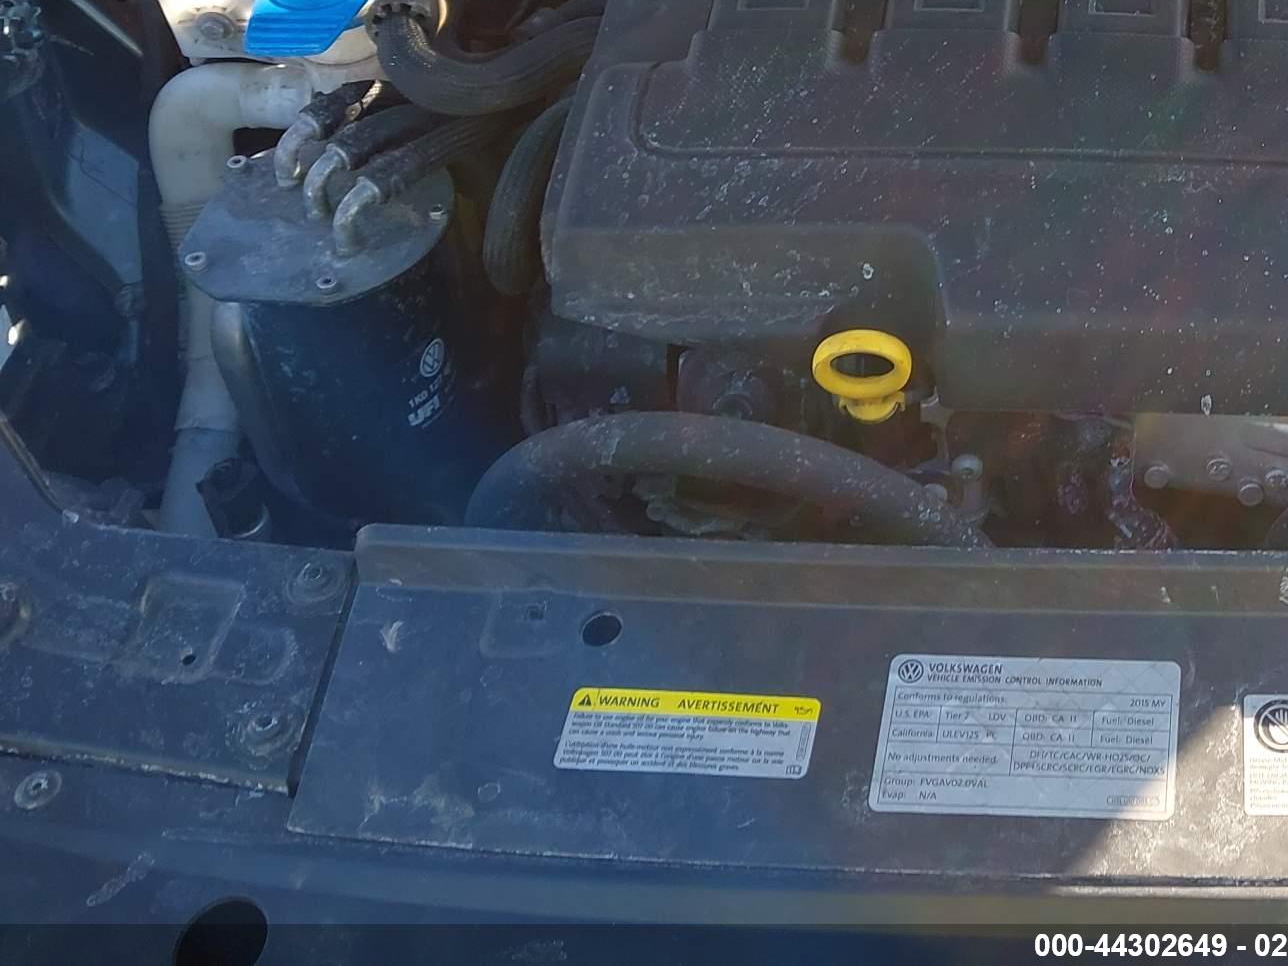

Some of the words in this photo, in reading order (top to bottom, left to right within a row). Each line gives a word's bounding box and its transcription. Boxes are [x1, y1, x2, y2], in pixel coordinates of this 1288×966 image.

[928, 663, 1003, 675] VOLKSWAGEN
[926, 673, 960, 683] VEHICLE
[962, 674, 1002, 684] EMISSION
[1004, 675, 1041, 686] CONTROL
[1045, 677, 1103, 687] INFORMATION
[897, 692, 941, 701] Conforms
[599, 695, 660, 708] WARNING
[677, 698, 780, 715] AVERTISSEMENT
[1129, 698, 1150, 707] 2015
[1151, 698, 1167, 708] MY
[945, 711, 962, 720] Tier
[987, 713, 1007, 722] LDV
[1051, 714, 1065, 723] CA
[1127, 717, 1155, 727] Diesel
[1049, 733, 1063, 742] CA
[1125, 735, 1153, 745] Diesel
[887, 752, 901, 761] No
[903, 752, 961, 763] adjustments
[919, 791, 937, 801] N/A
